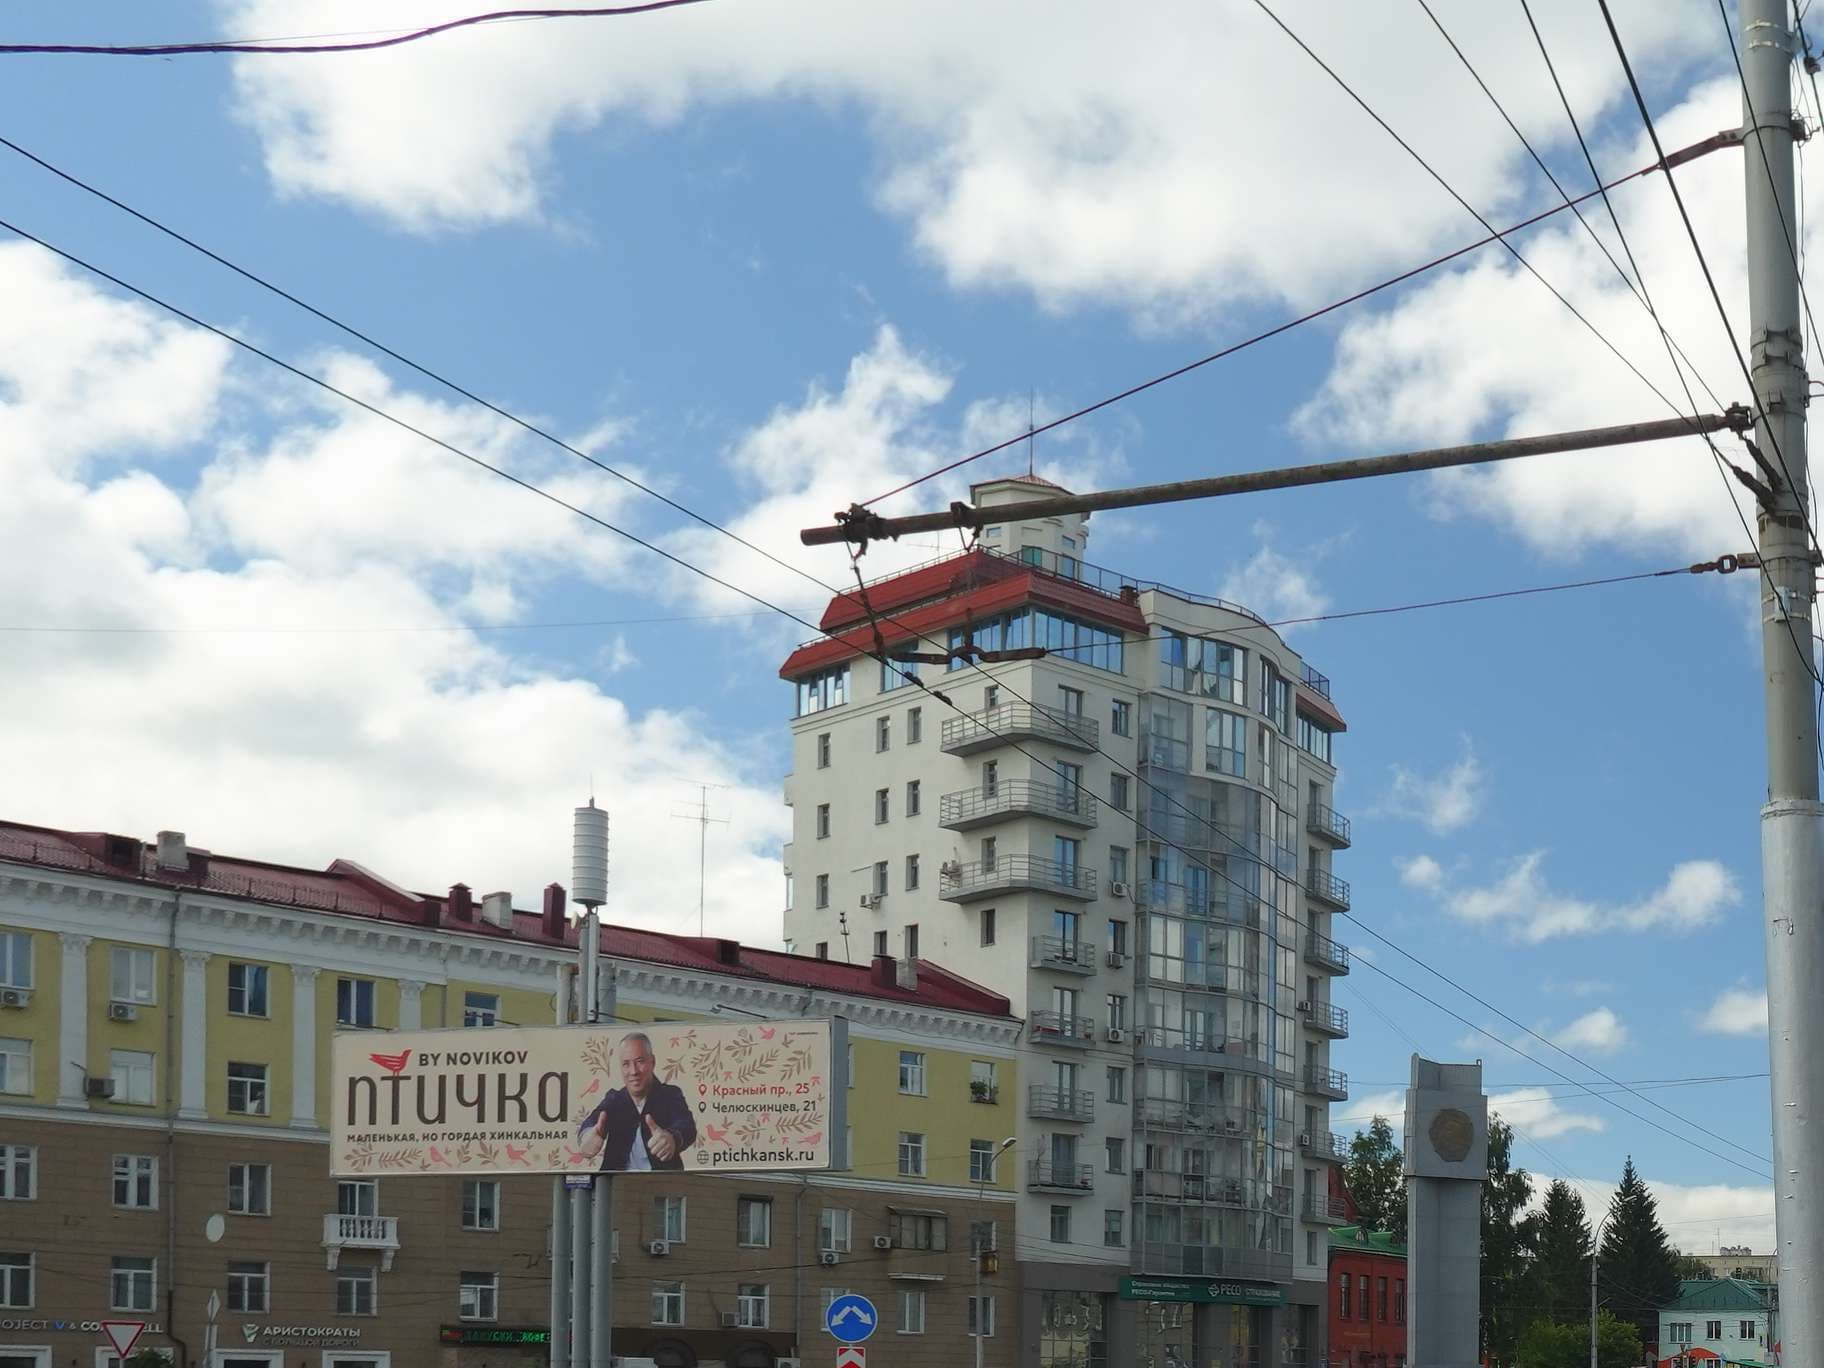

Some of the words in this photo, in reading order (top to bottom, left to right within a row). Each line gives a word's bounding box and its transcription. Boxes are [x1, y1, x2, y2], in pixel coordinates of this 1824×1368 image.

[418, 1053, 442, 1067] BY
[446, 1050, 529, 1066] NOVIKOV
[712, 1084, 767, 1099] Красный
[770, 1085, 792, 1097] пр.,
[795, 1082, 810, 1094] 25
[712, 1102, 800, 1114] Челюскинцев,
[803, 1100, 816, 1112] 21
[347, 1132, 419, 1143] МАЛЕНЬКАЯ,
[422, 1132, 438, 1142] НО
[441, 1131, 487, 1142] ГОРДАЯ
[489, 1130, 568, 1141] ХИНКАЛЬНАЯ
[712, 1147, 815, 1166] ptichkansk.ru
[0, 1319, 49, 1330] OJECT
[262, 1326, 361, 1337] АРИСТОКРАТЫ
